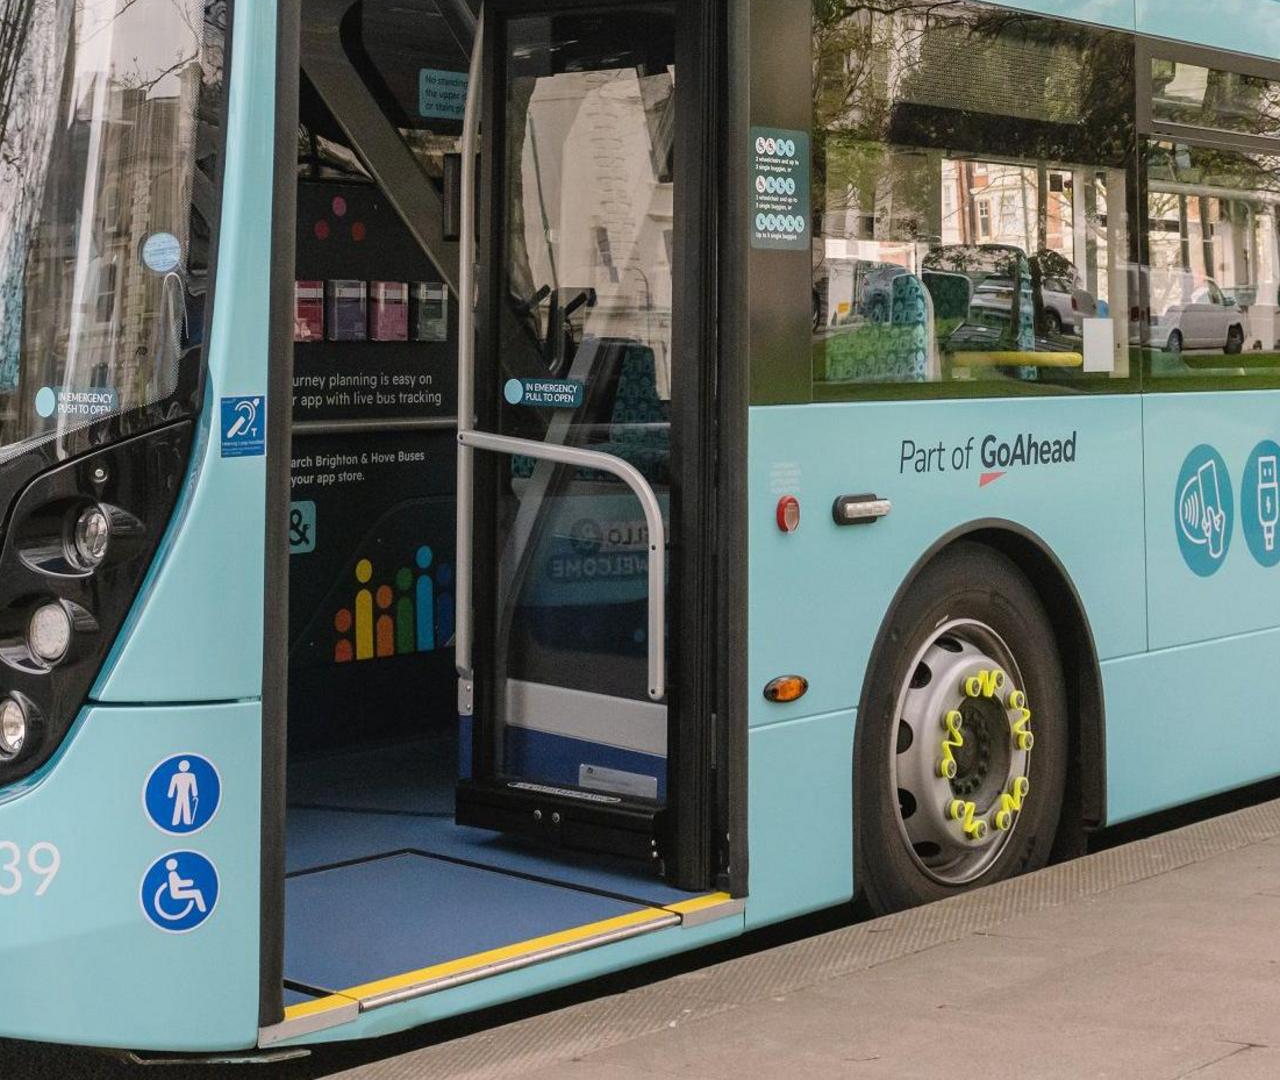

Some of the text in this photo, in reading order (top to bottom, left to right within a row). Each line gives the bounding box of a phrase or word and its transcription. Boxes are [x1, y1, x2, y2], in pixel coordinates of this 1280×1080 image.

[292, 372, 432, 389] urney planning is easy on
[526, 383, 578, 393] IN EMERGENCY
[67, 393, 113, 404] EMERGENCY
[300, 395, 323, 409] app
[326, 392, 350, 406] with
[354, 391, 373, 405] live
[376, 391, 396, 404] bus
[399, 391, 442, 407] tracking
[525, 392, 574, 403] PULL TO OPEN
[58, 403, 79, 412] PUSH
[79, 405, 91, 413] TO
[250, 427, 258, 437] T
[899, 431, 1077, 474] Part of GoAhead
[290, 451, 425, 469] arch Brighton & Hove Buses
[291, 472, 365, 488] your app store.
